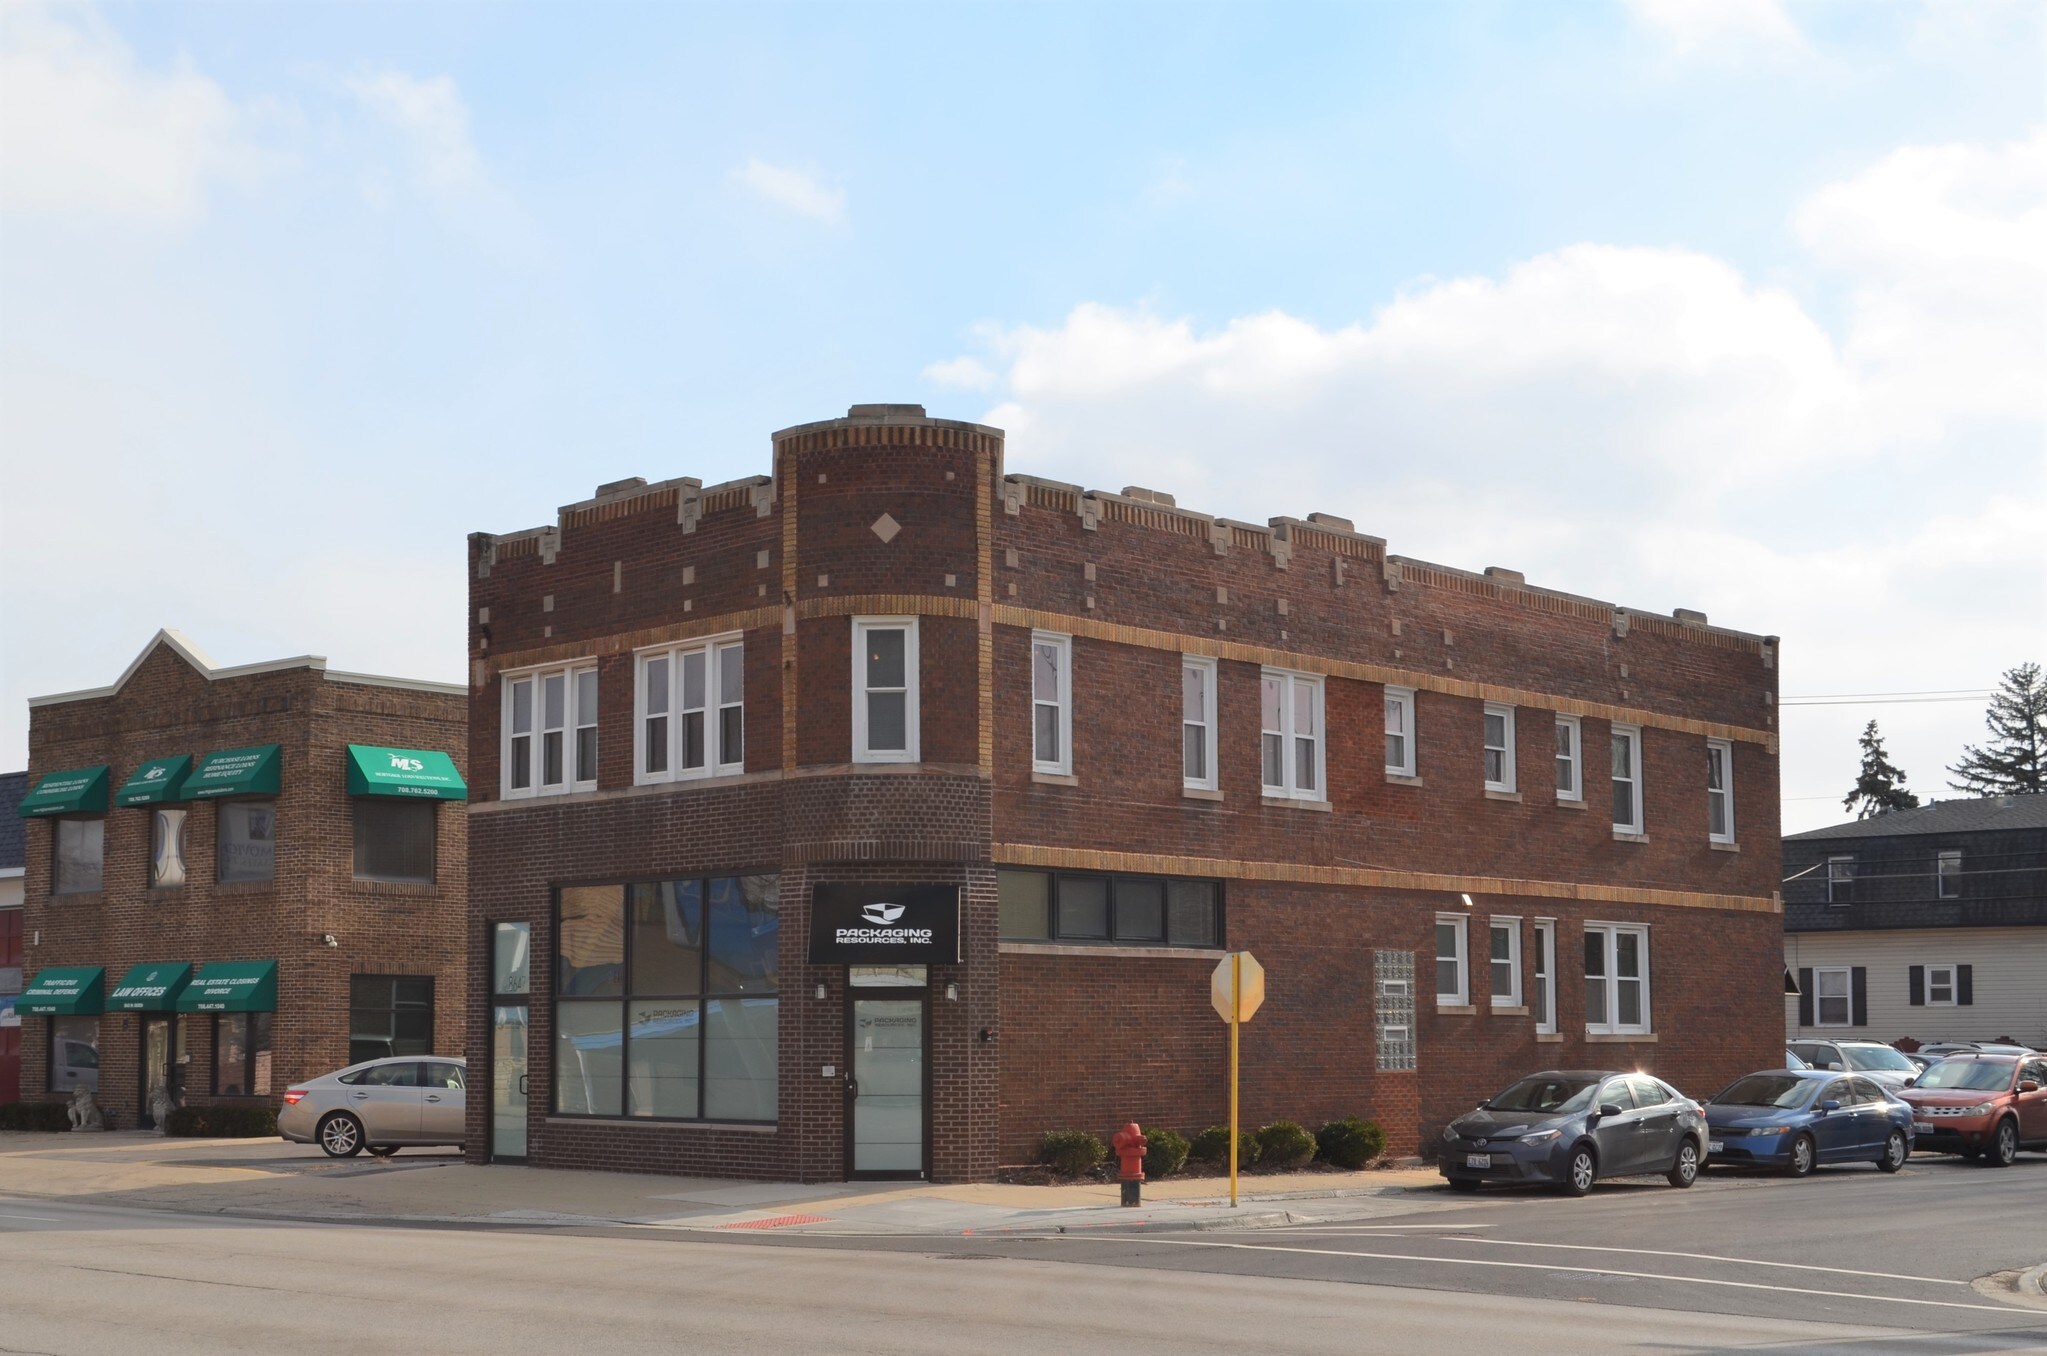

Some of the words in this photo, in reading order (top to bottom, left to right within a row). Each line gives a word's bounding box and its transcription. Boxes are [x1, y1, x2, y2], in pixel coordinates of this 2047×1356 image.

[390, 757, 424, 772] MLS
[397, 786, 438, 795] 708.762.5200
[836, 928, 932, 938] PACKAGING
[836, 937, 907, 945] RESOURCES,
[229, 977, 260, 985] CLOSINGS
[112, 987, 133, 997] LAW
[130, 986, 167, 997] OFFICES
